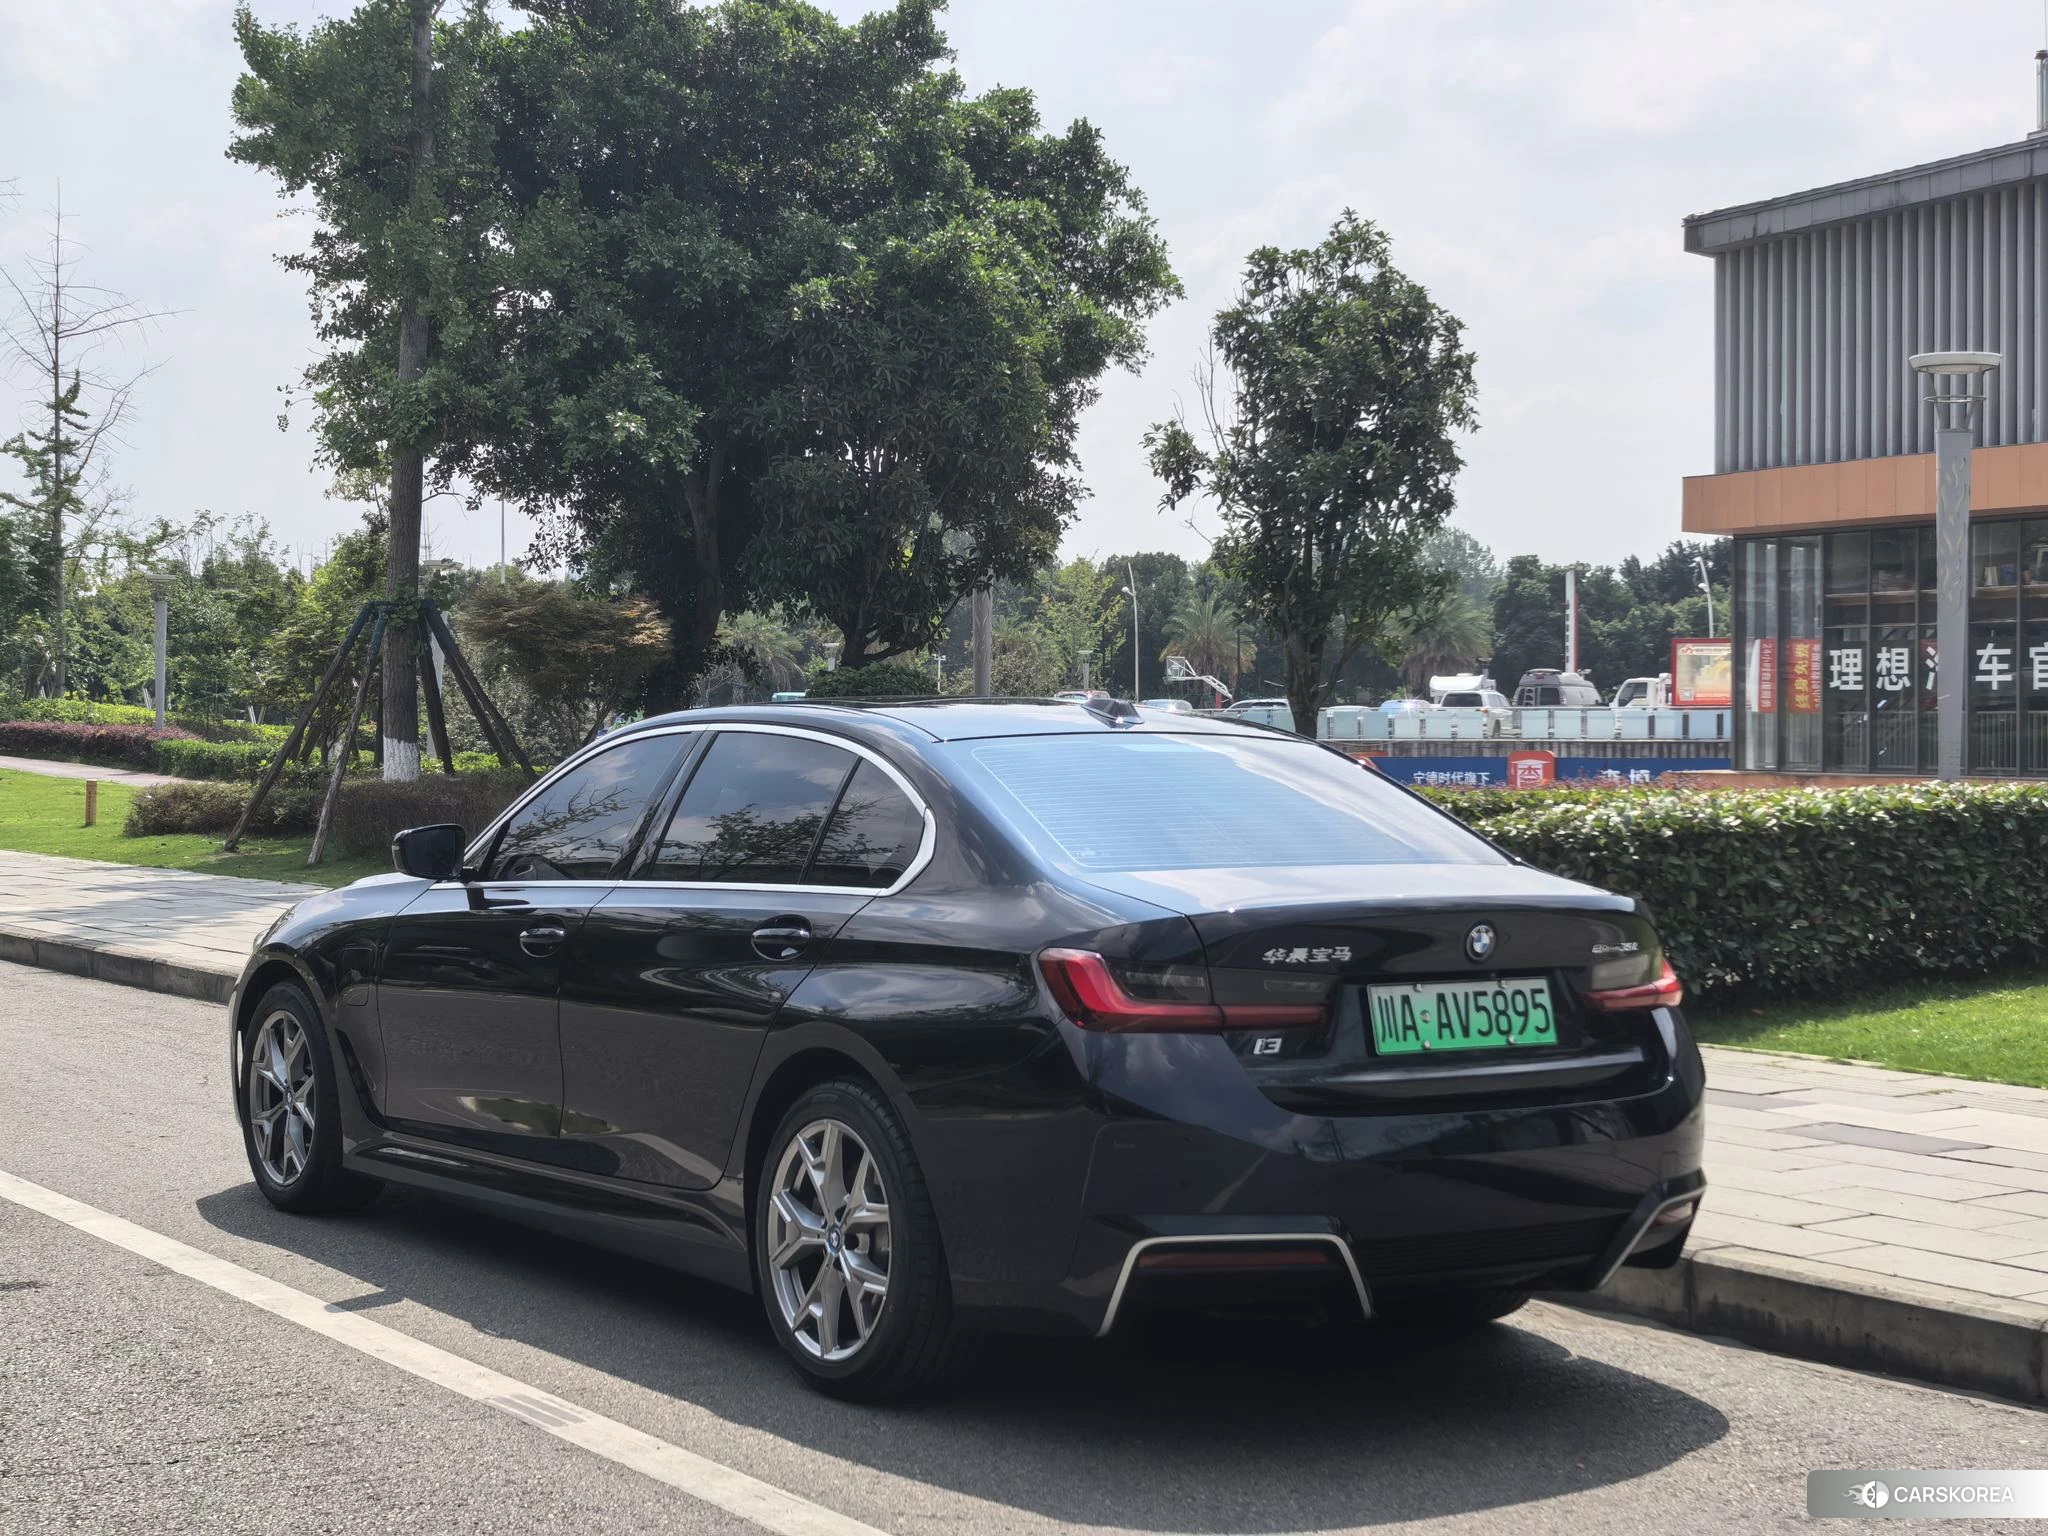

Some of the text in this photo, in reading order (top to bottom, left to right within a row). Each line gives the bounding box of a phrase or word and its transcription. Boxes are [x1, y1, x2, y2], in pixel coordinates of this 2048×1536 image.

[1413, 771, 1491, 785] 宁德时代旗下
[1262, 946, 1352, 964] 华晨宝马
[1436, 988, 1549, 1040] AV5895
[1253, 1038, 1282, 1055] i3
